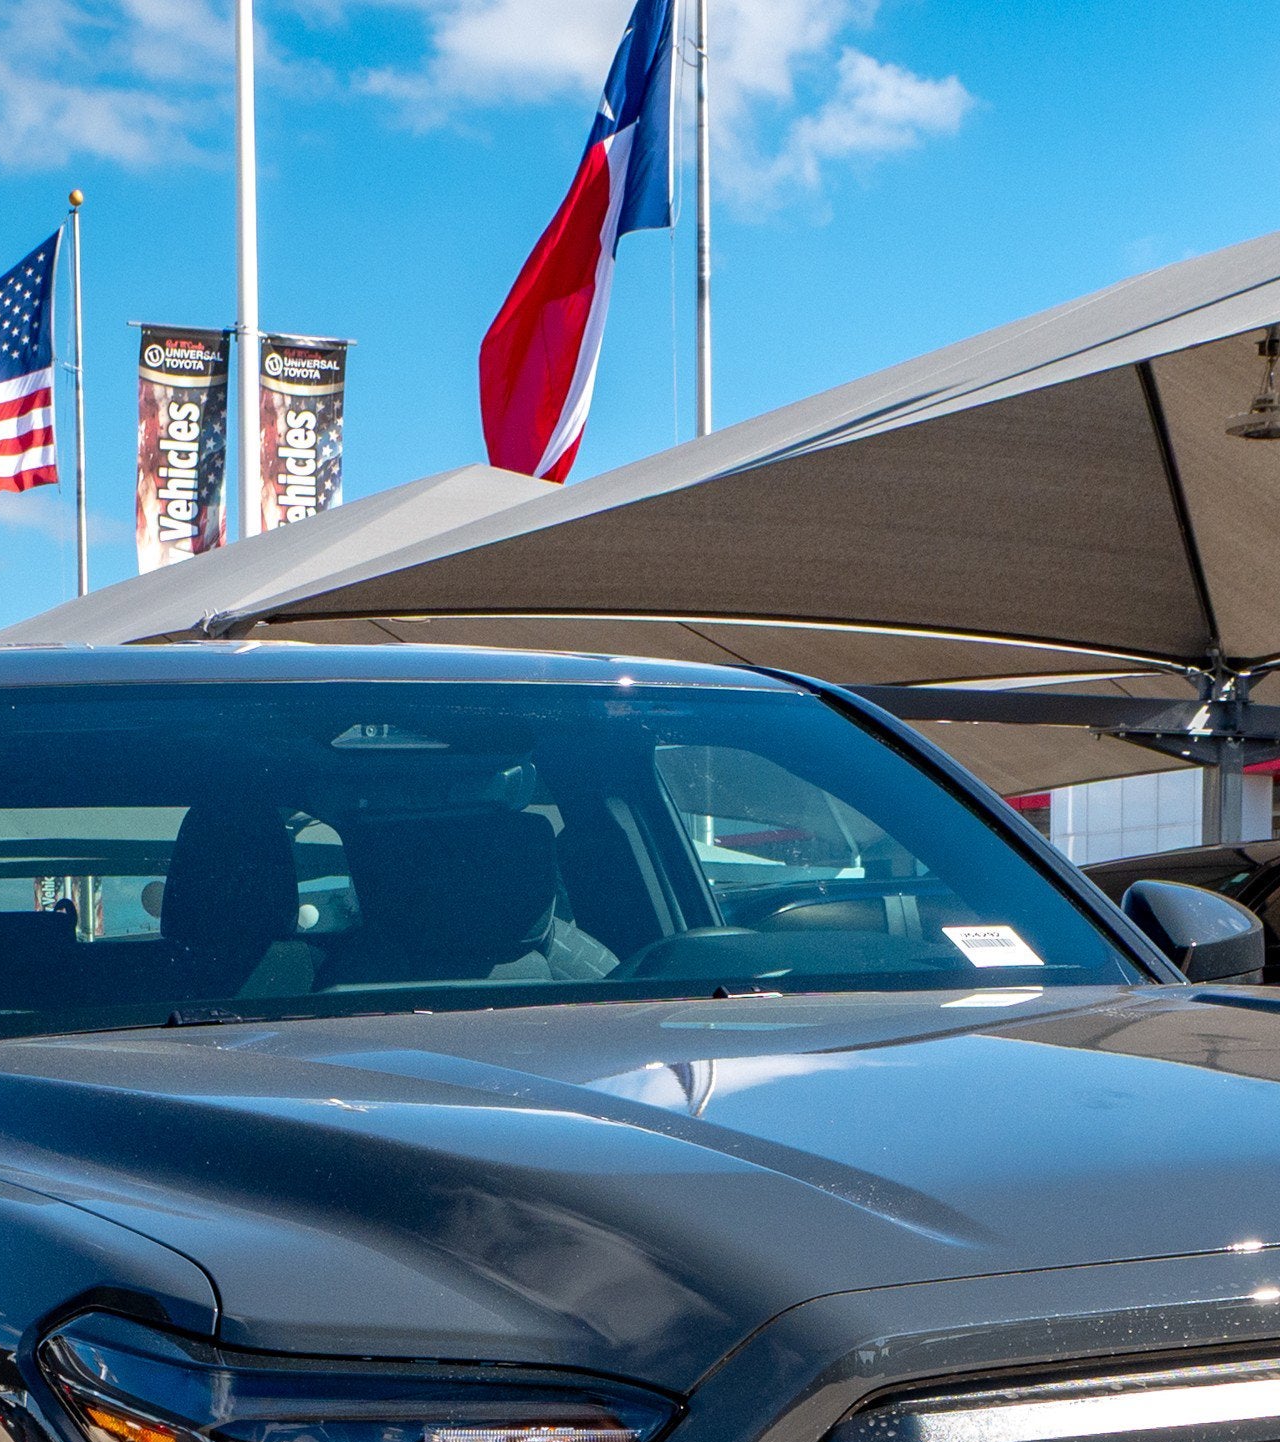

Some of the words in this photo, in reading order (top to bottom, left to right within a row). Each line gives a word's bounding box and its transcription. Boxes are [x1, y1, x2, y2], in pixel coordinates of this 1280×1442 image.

[165, 348, 223, 361] UNIVERSAL
[165, 358, 204, 371] TOYOTA
[283, 357, 340, 370] UNIVERSAL
[283, 367, 321, 379] TOYOTA
[158, 401, 201, 542] Vehicles
[278, 410, 317, 528] ehicles
